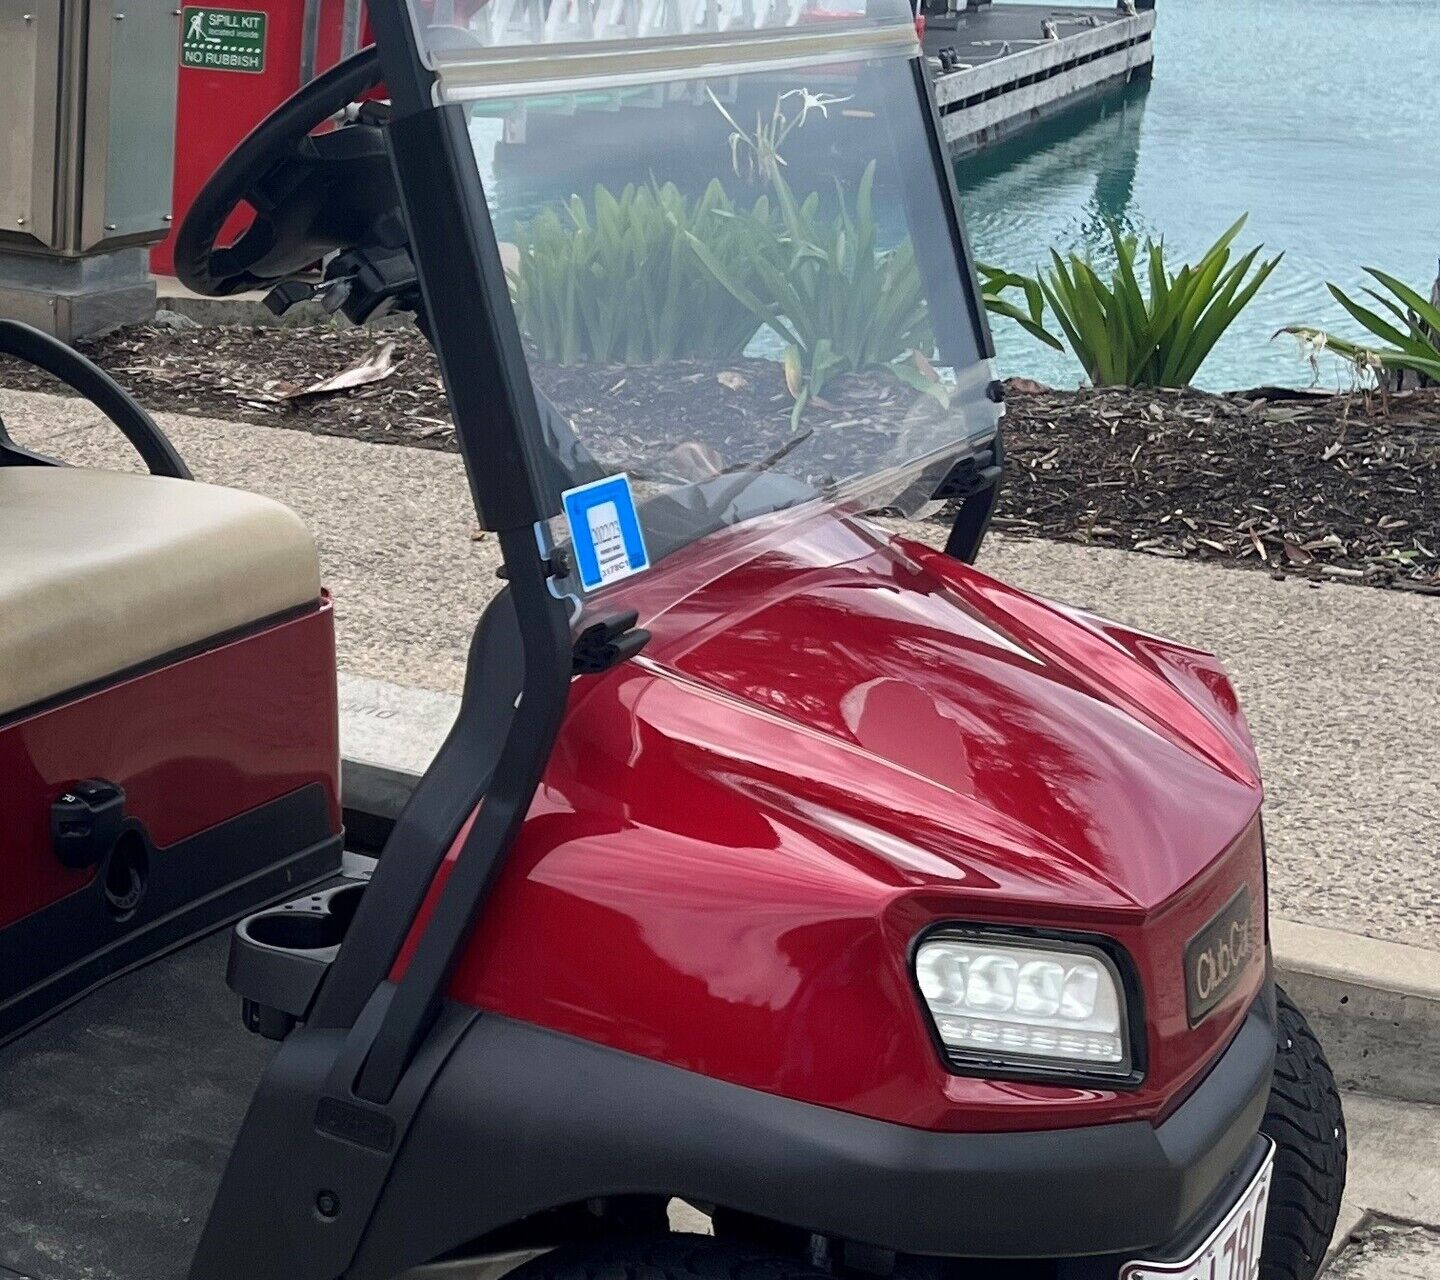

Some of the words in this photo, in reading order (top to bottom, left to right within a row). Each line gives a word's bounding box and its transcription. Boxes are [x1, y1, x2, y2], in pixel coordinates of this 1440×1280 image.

[208, 13, 240, 28] SPILL
[241, 16, 260, 29] KIT
[185, 51, 203, 63] NO
[205, 53, 259, 67] RUBBISH
